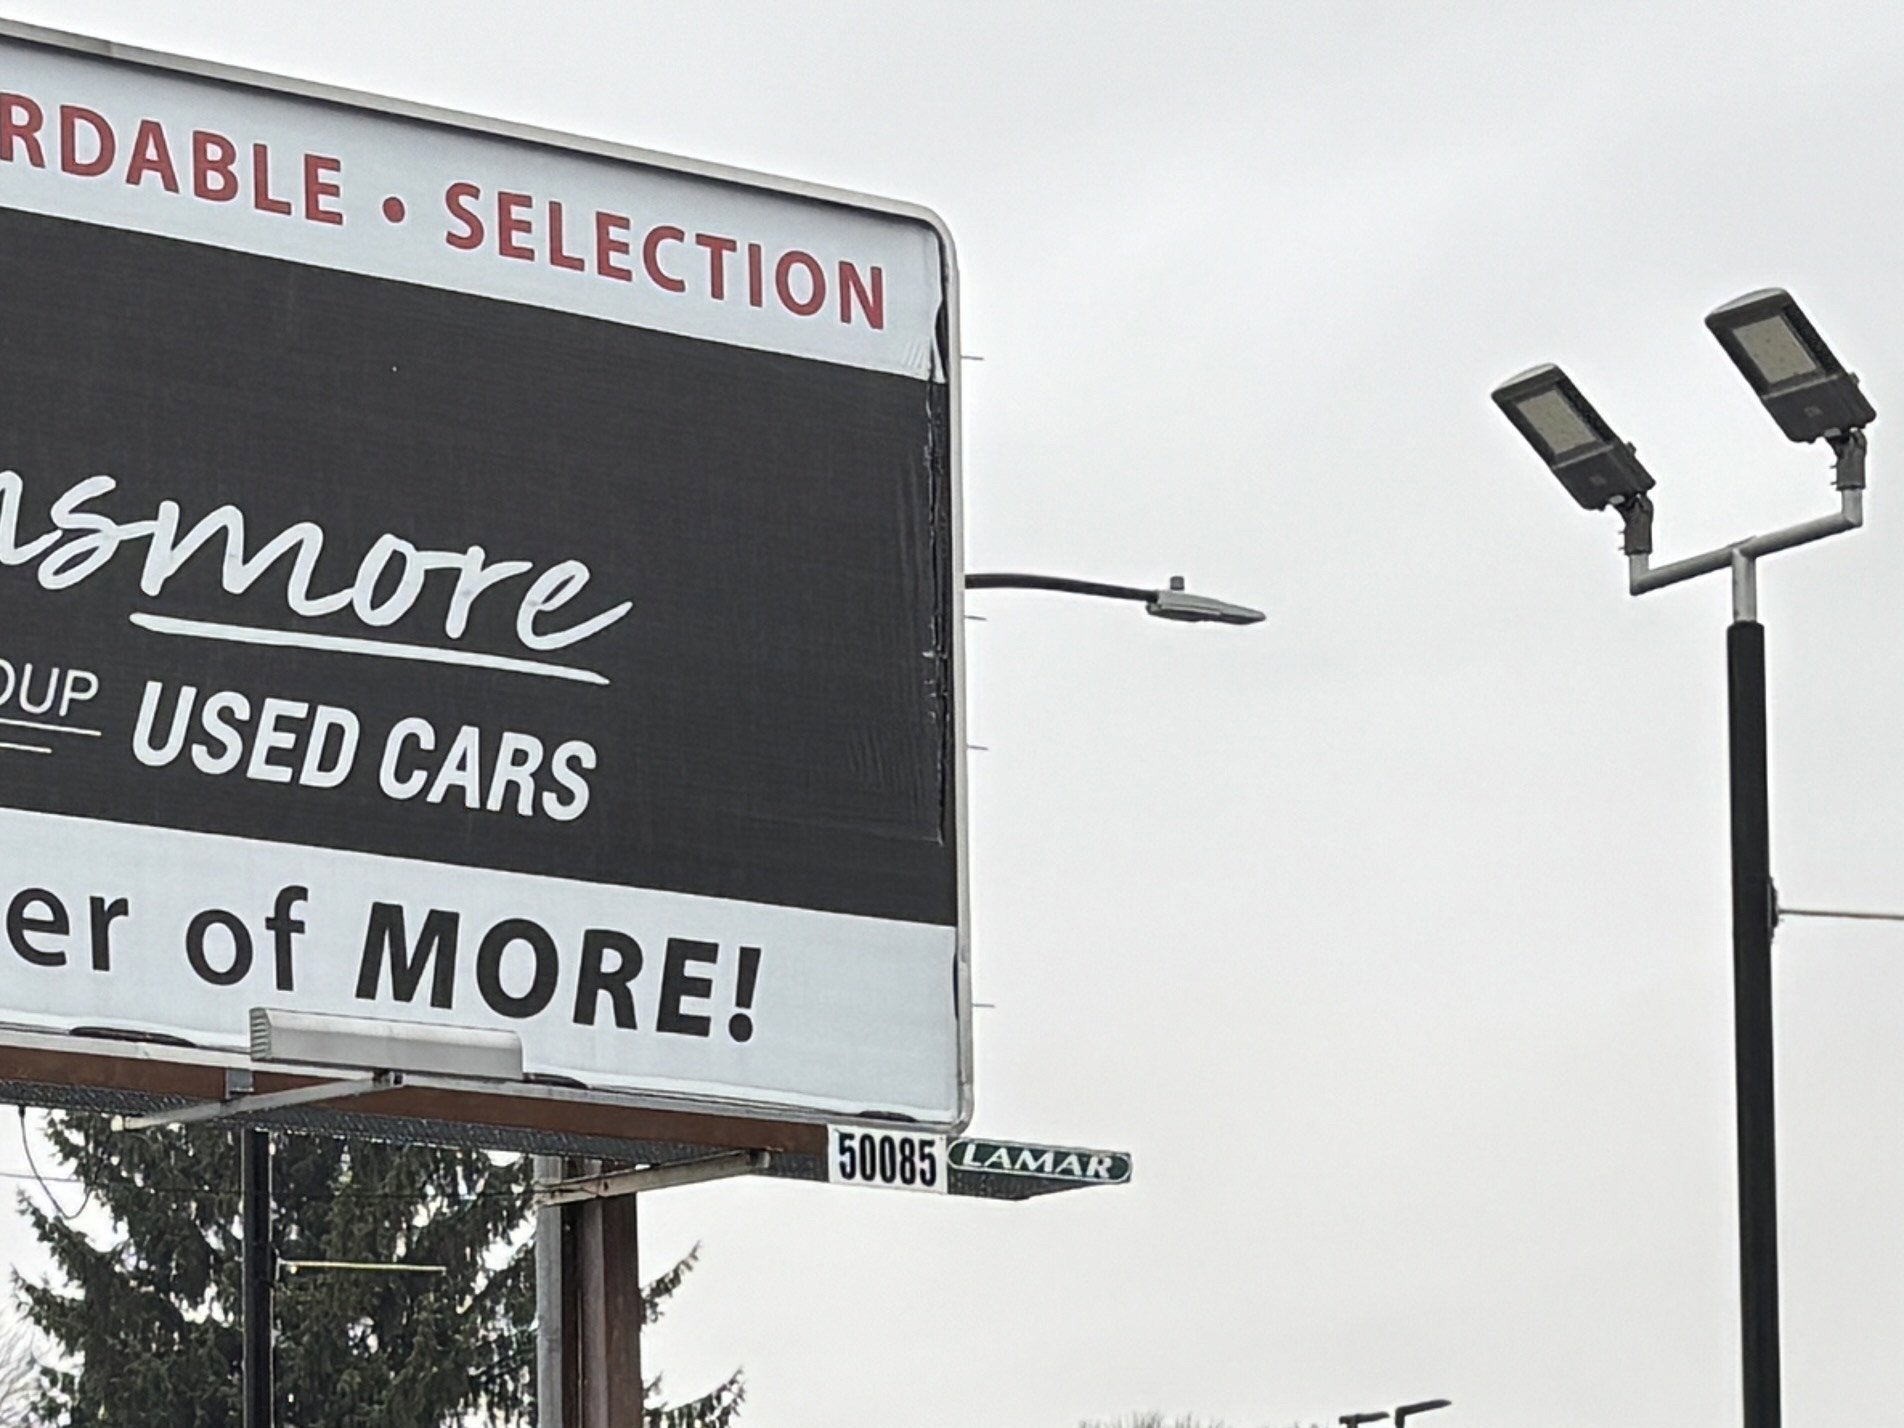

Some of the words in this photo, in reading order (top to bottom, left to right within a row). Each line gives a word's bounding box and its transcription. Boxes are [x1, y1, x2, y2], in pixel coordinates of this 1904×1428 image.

[446, 182, 884, 329] SELECTION
[131, 679, 361, 789] USED
[378, 716, 598, 822] CARS
[184, 884, 310, 993] of
[354, 900, 764, 1044] MORE!
[838, 1131, 938, 1188] 50085
[962, 1143, 1112, 1179] LAMAR
